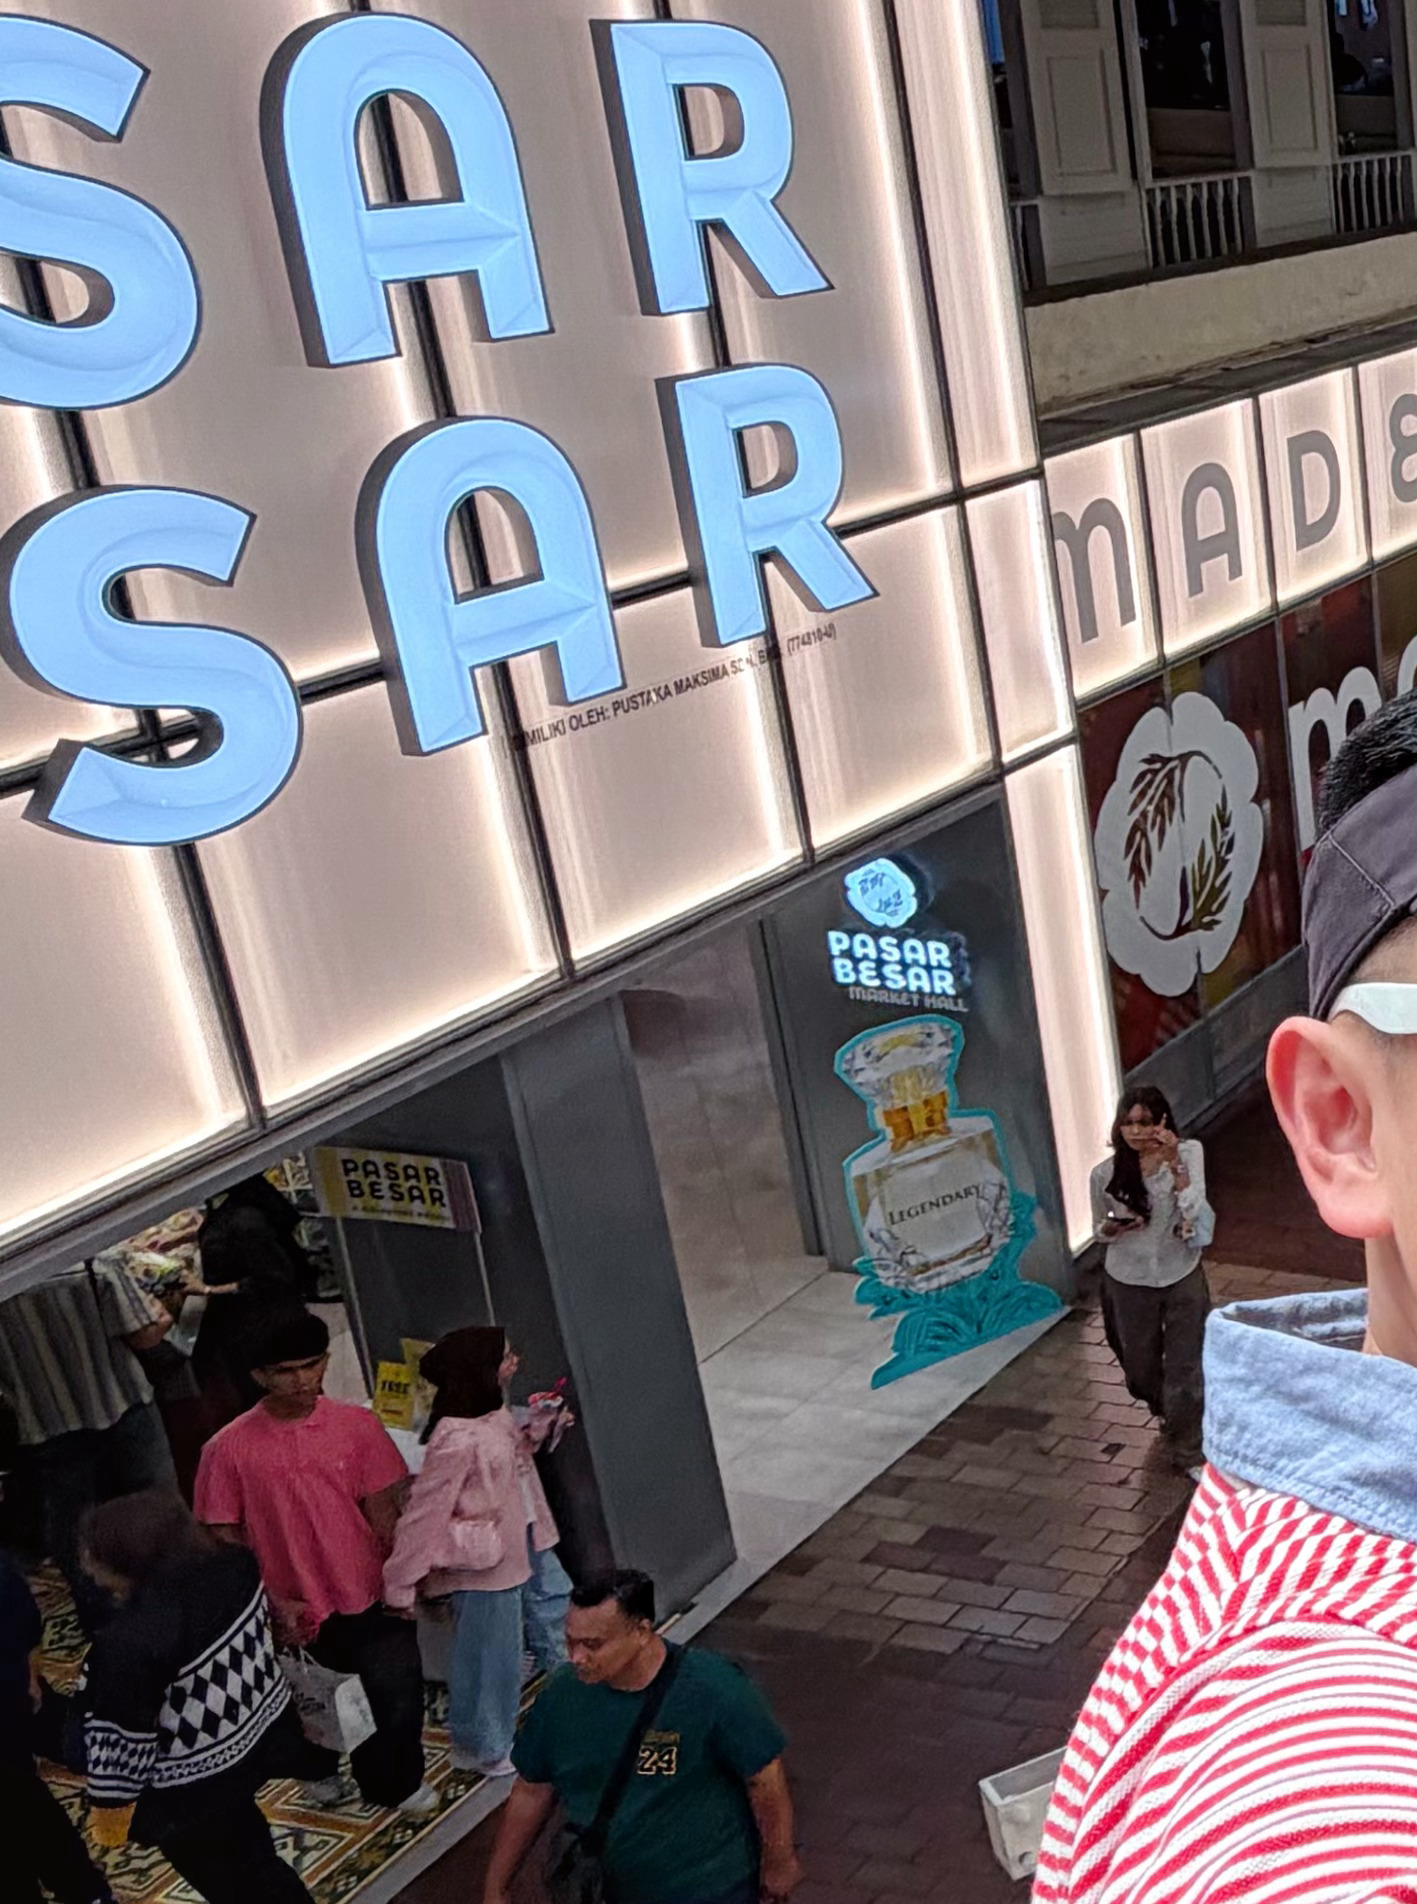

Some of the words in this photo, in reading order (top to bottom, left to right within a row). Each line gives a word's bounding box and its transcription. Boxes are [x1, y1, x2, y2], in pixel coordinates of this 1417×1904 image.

[8, 363, 878, 848] SAR
[674, 662, 731, 696] MAKSIMA
[827, 929, 953, 969] PASAR
[832, 957, 957, 996] BESAR
[923, 995, 969, 1013] HALL
[341, 1158, 443, 1187] PASAR
[346, 1179, 447, 1208] BESAR
[887, 1182, 983, 1226] LEGENDARY
[637, 1745, 678, 1775] 24
